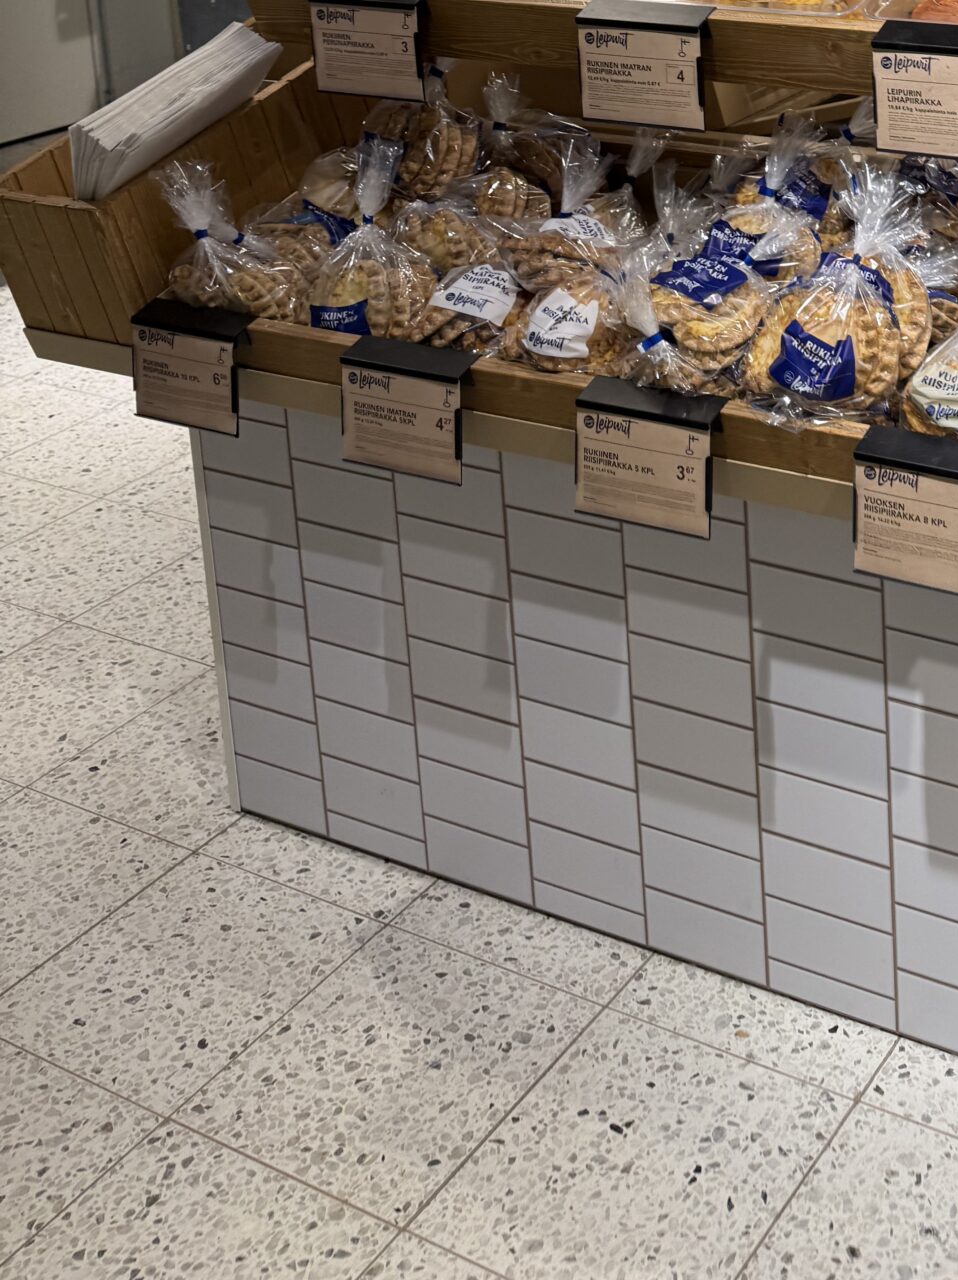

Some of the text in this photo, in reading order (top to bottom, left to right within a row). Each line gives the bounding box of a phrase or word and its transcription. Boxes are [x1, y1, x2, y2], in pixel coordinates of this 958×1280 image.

[401, 41, 409, 53] 3
[596, 30, 635, 50] Leipurit
[620, 62, 652, 71] IMATRAN
[894, 54, 940, 76] Leipurit
[676, 70, 685, 82] 4
[887, 88, 922, 97] LEIPURIN
[887, 96, 942, 107] LIHAPIIRAKKA
[213, 372, 221, 385] 6
[359, 370, 396, 394] Leipurit
[386, 407, 417, 419] IMATRAN
[435, 417, 444, 431] 4
[595, 413, 639, 439] Leipurit
[583, 447, 619, 460] RUKIINEN
[583, 455, 633, 471] RIISIPIIRAKKA
[641, 466, 656, 476] KPL
[676, 465, 686, 480] 3
[878, 464, 919, 493] Leipurit
[863, 495, 905, 511] VUOKSEN
[863, 503, 921, 522] RIISIPIIRAKKA
[931, 516, 948, 528] KPL
